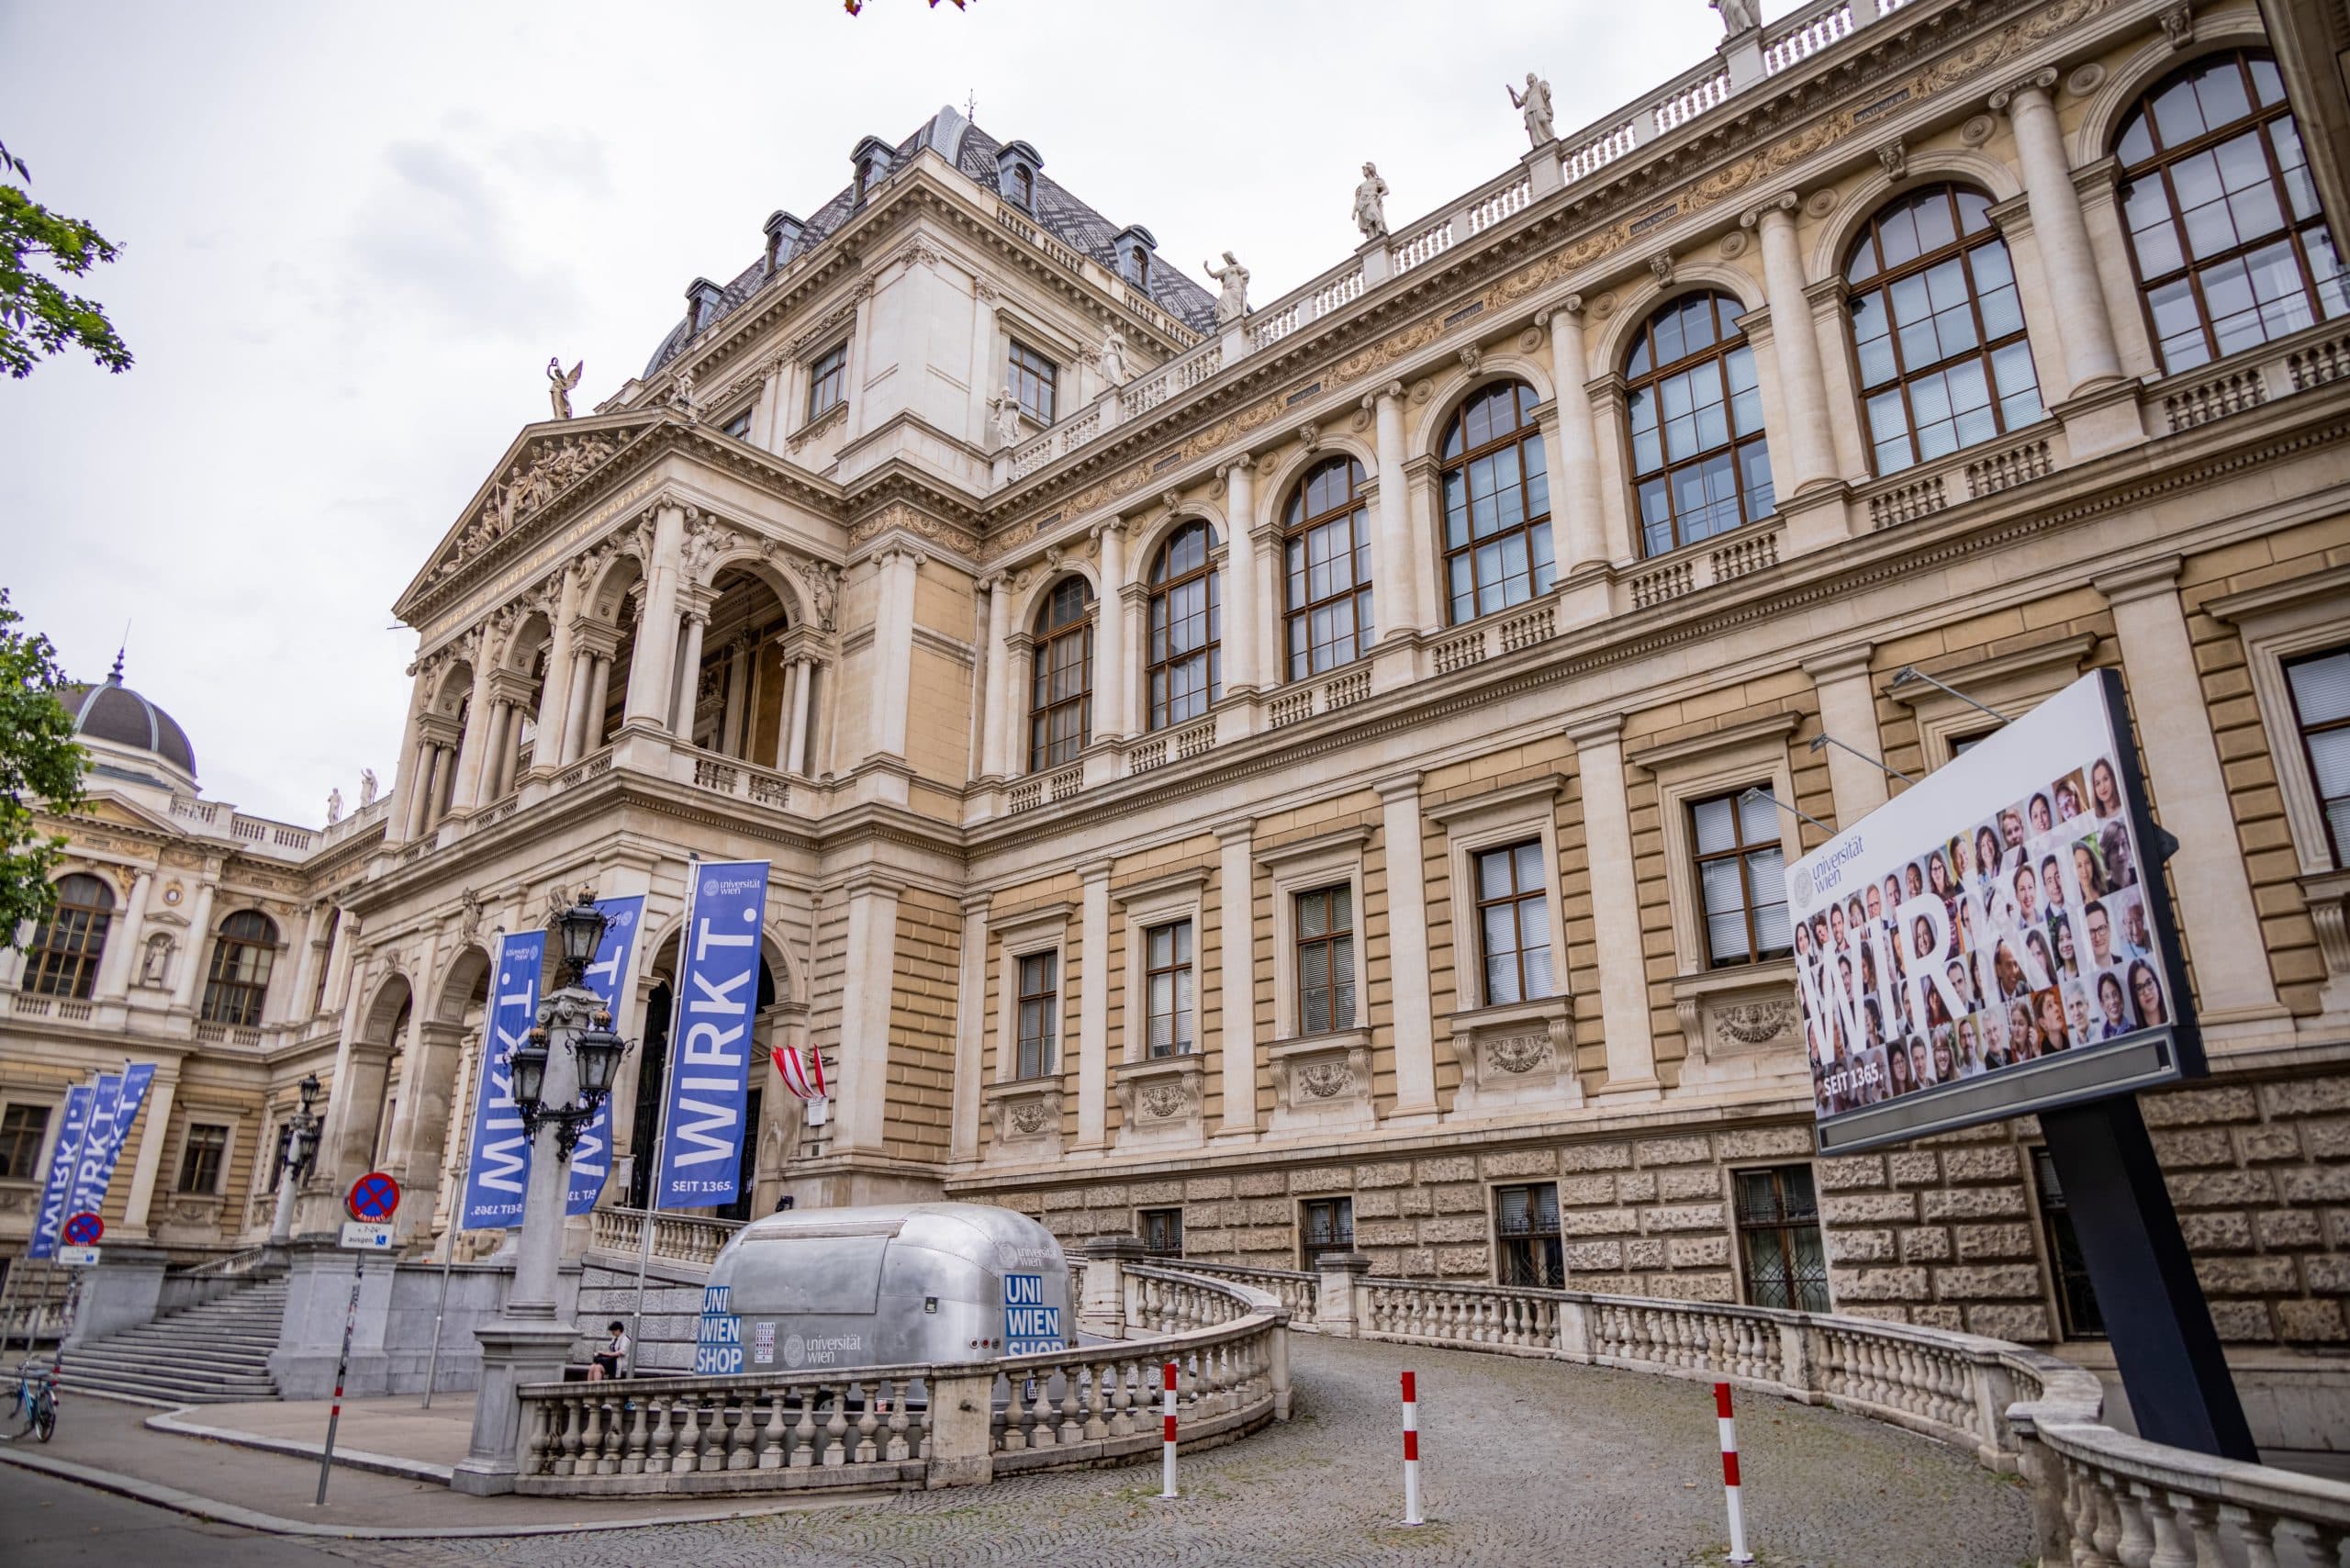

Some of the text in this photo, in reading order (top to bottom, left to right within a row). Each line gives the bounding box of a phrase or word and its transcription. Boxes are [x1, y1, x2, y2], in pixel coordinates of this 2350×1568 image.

[1812, 834, 1863, 880] universität
[720, 879, 760, 889] universität
[1815, 868, 1841, 894] wien
[674, 907, 757, 1168] WIRKT.
[1823, 1062, 1884, 1097] SEIT 1365.
[672, 1181, 733, 1192] SEIT 1365.
[1020, 1257, 1042, 1267] wien
[702, 1288, 729, 1313] UNI
[1005, 1277, 1042, 1304] UNI
[700, 1317, 741, 1342] WIEN
[1008, 1309, 1058, 1336] WIEN
[806, 1334, 861, 1352] universität
[697, 1347, 743, 1373] SHOP
[808, 1350, 835, 1364] wien
